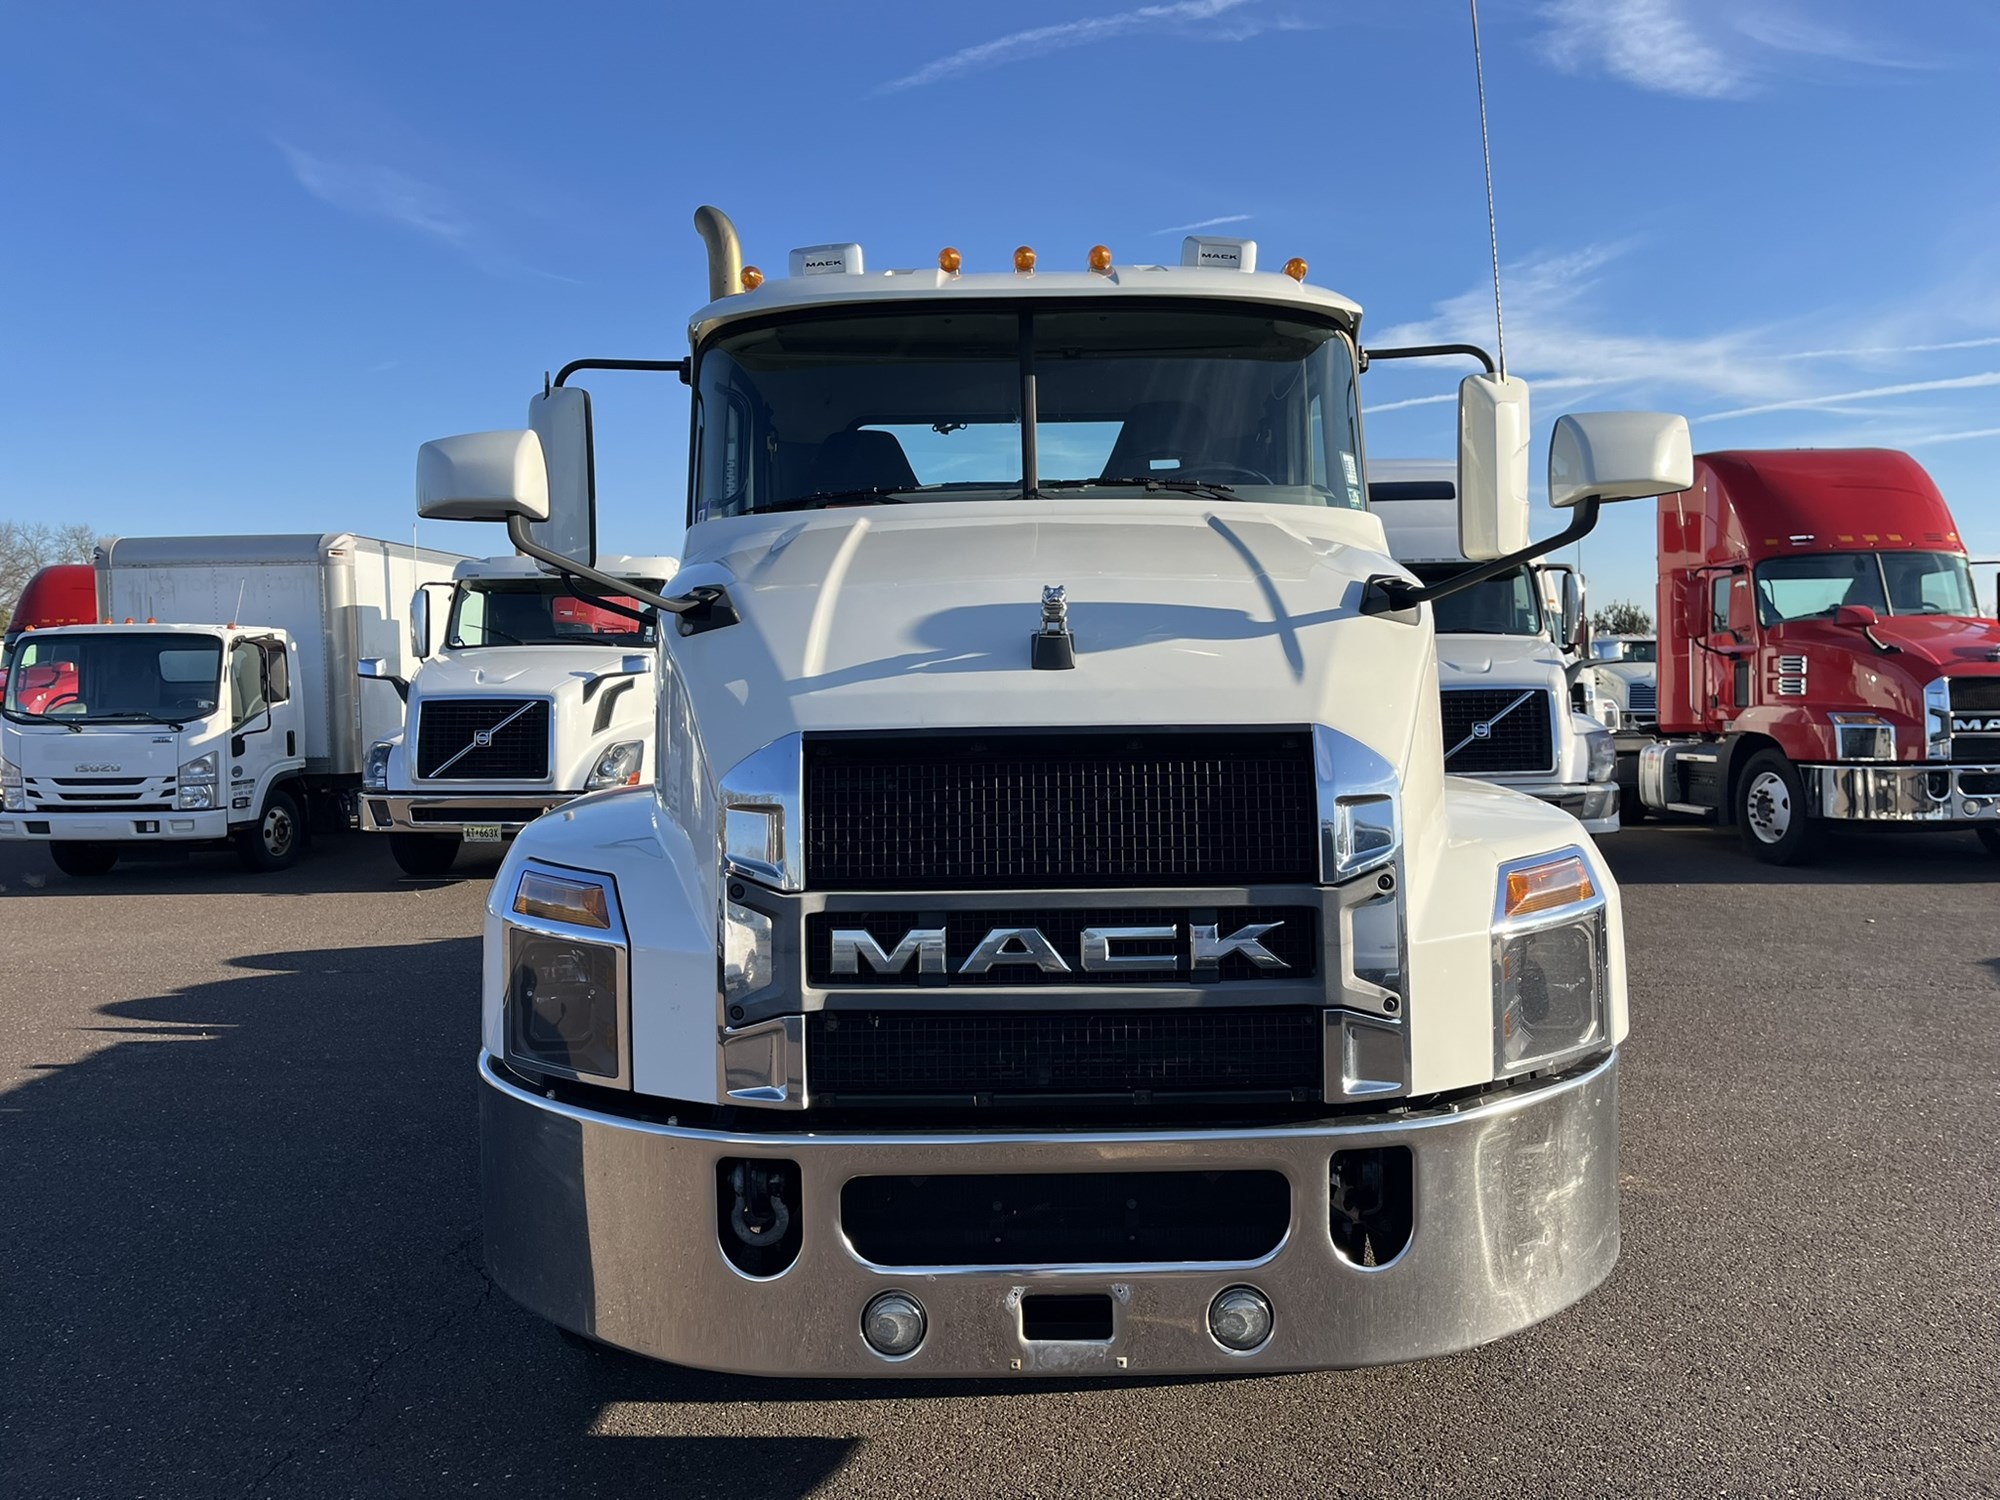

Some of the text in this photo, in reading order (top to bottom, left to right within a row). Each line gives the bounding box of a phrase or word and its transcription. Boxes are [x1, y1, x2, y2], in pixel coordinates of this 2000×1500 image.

[805, 260, 842, 268] MACK
[75, 764, 121, 773] ISUZU
[830, 920, 1292, 974] MACK
